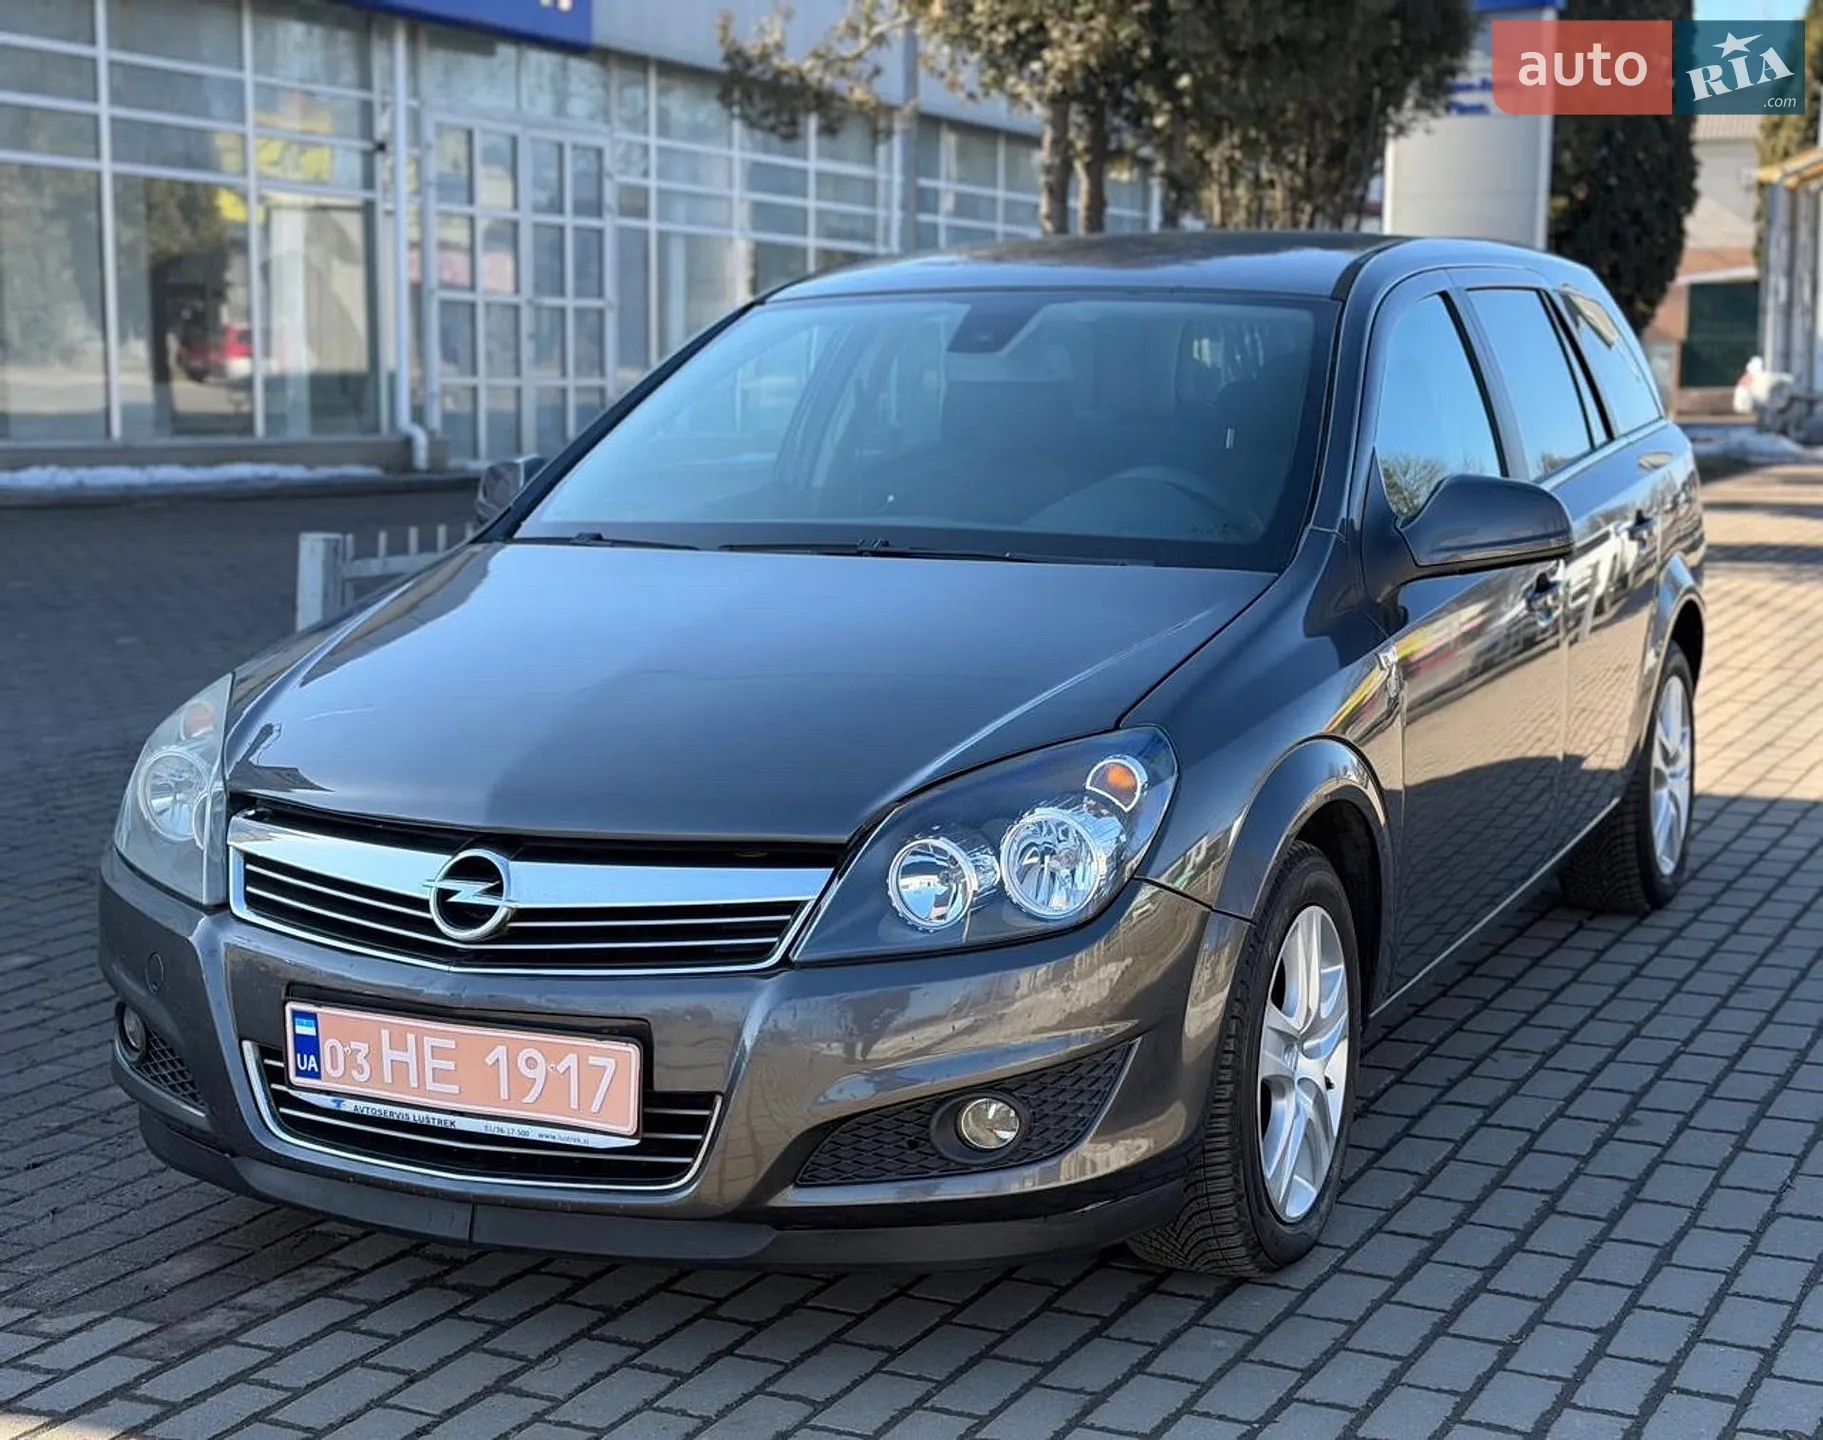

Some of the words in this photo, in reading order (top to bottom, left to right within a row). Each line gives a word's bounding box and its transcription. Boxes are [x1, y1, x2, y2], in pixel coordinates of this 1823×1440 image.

[296, 1053, 319, 1072] UA
[323, 1038, 371, 1082] 03
[381, 1029, 460, 1094] HE
[484, 1045, 616, 1112] 1917
[353, 1104, 410, 1121] AVTOSERVIS
